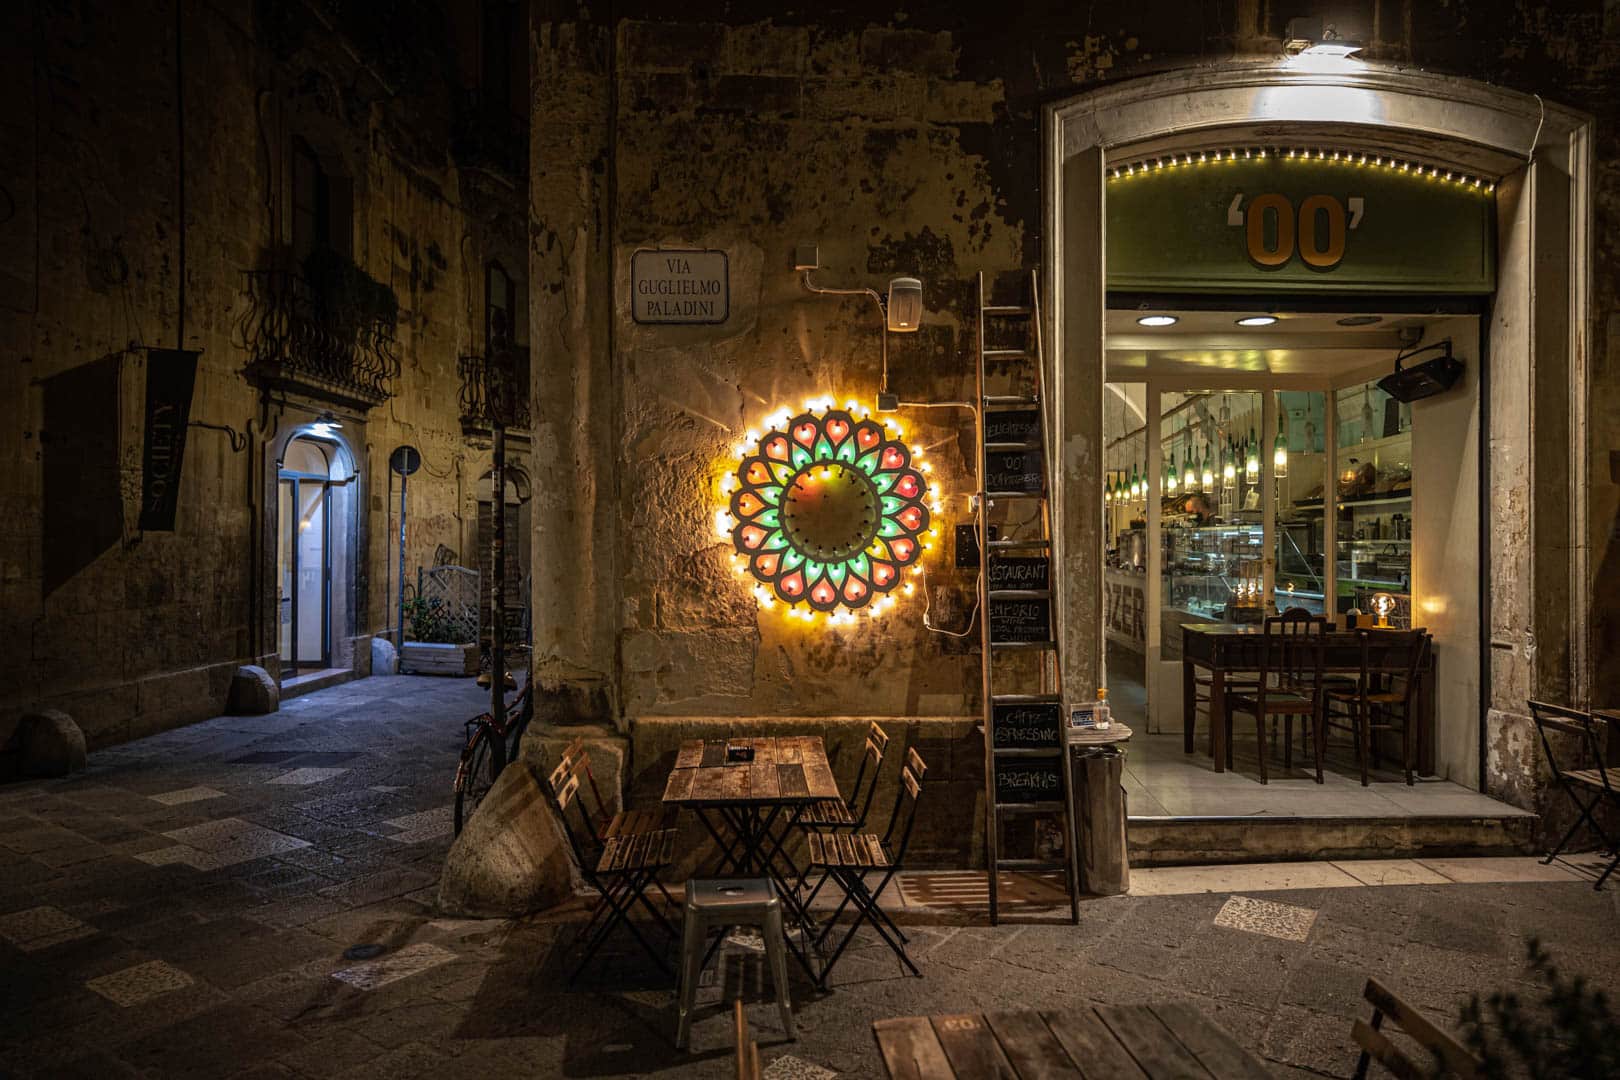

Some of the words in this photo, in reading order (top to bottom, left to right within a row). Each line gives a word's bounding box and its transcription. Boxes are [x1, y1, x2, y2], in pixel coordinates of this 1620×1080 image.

[666, 258, 691, 274] VIA
[638, 279, 721, 295] GUGLIELMO
[647, 301, 714, 316] PALADINI
